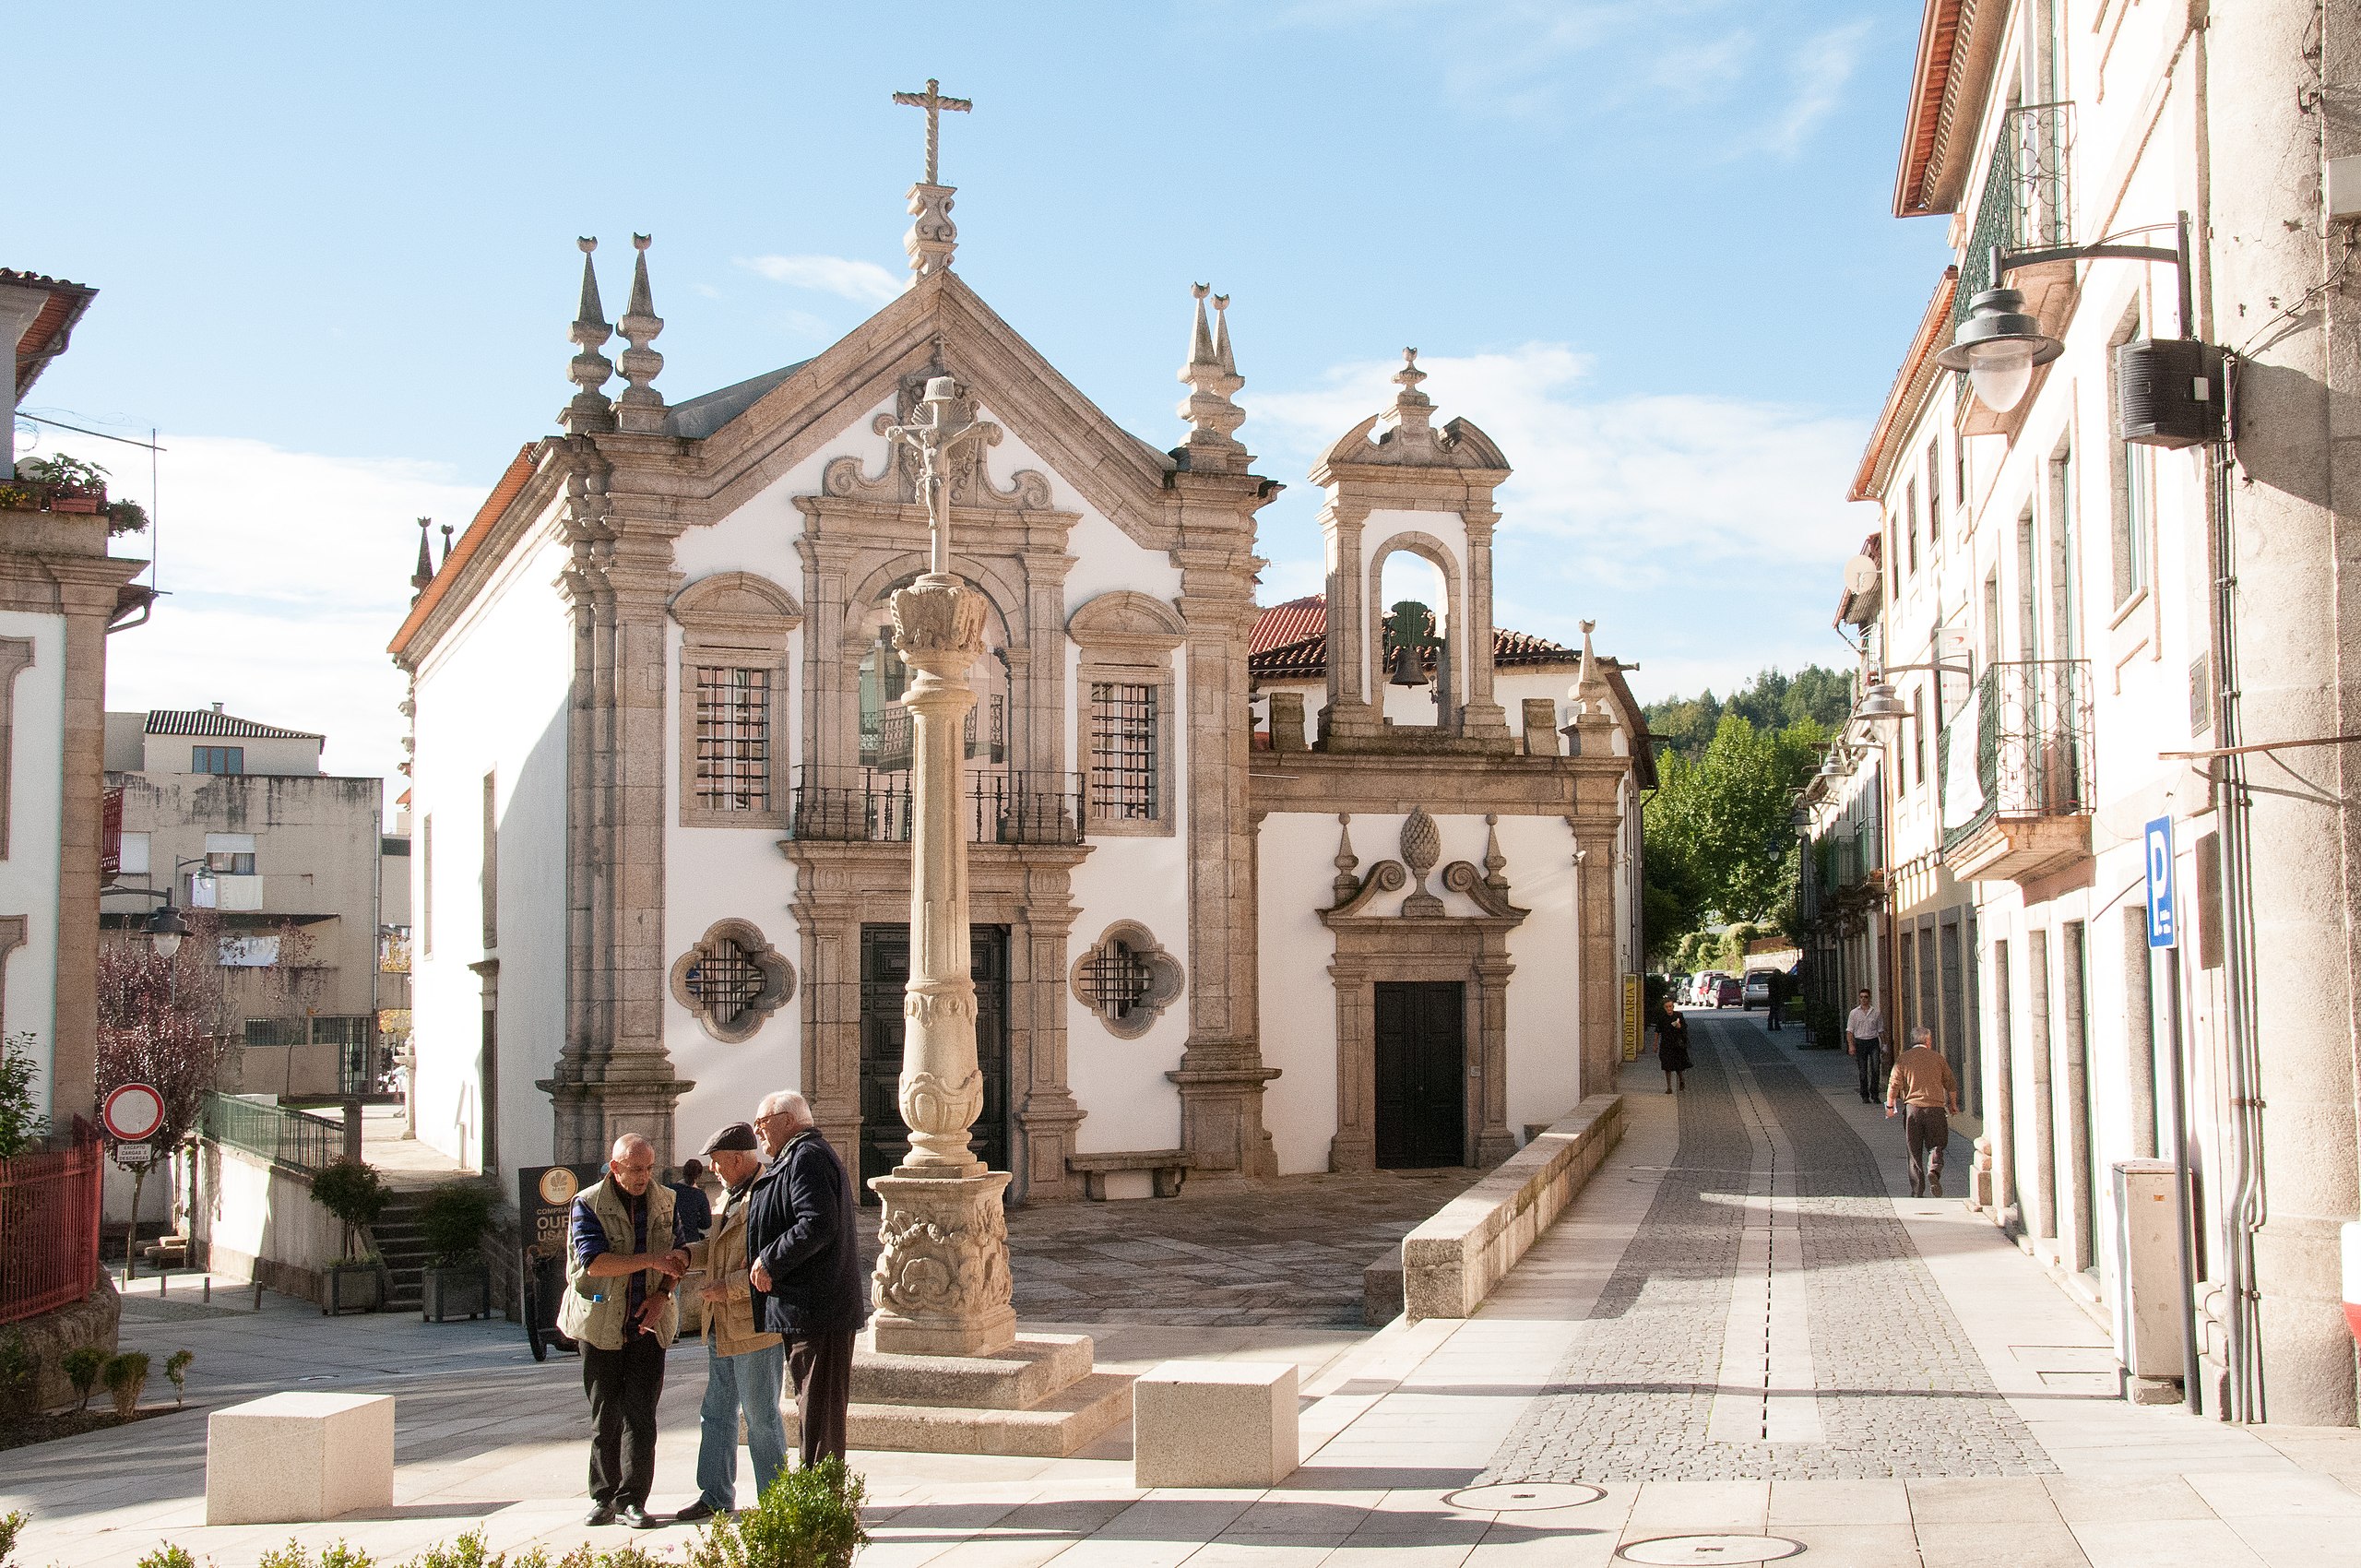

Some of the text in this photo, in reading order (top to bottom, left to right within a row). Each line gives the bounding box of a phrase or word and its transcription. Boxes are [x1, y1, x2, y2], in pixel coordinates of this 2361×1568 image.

[2149, 830, 2167, 936] P
[536, 1206, 570, 1215] COMPRA
[536, 1215, 569, 1229] OUR
[537, 1229, 564, 1241] USA
